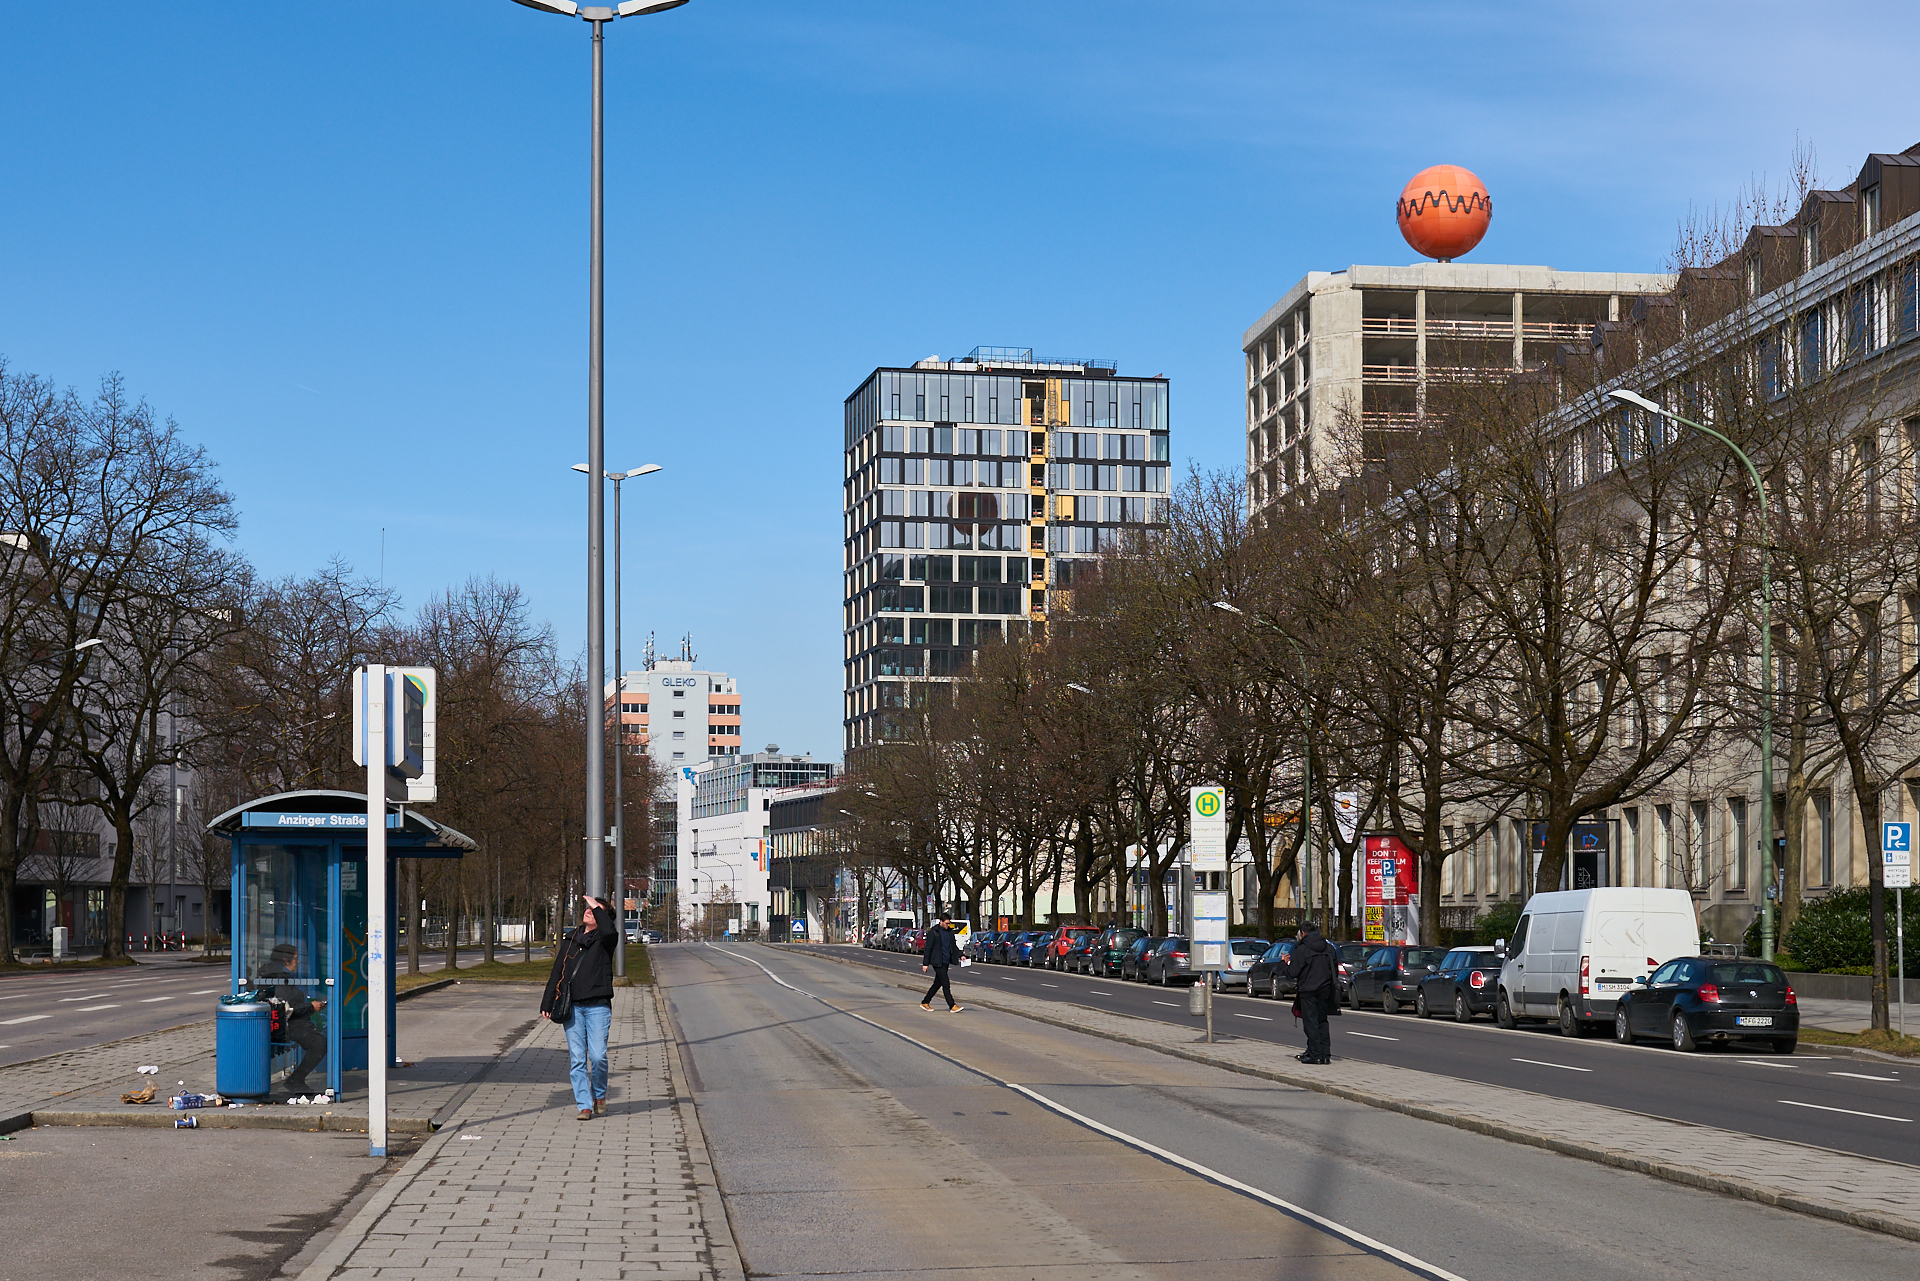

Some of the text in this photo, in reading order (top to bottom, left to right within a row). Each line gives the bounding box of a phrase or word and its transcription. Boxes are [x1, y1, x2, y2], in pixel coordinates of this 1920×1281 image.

[662, 677, 697, 687] GLEKO
[1202, 798, 1214, 811] H
[278, 815, 367, 827] Anzinger Straße
[1886, 825, 1903, 848] P
[1383, 861, 1391, 875] P
[271, 1010, 279, 1020] E
